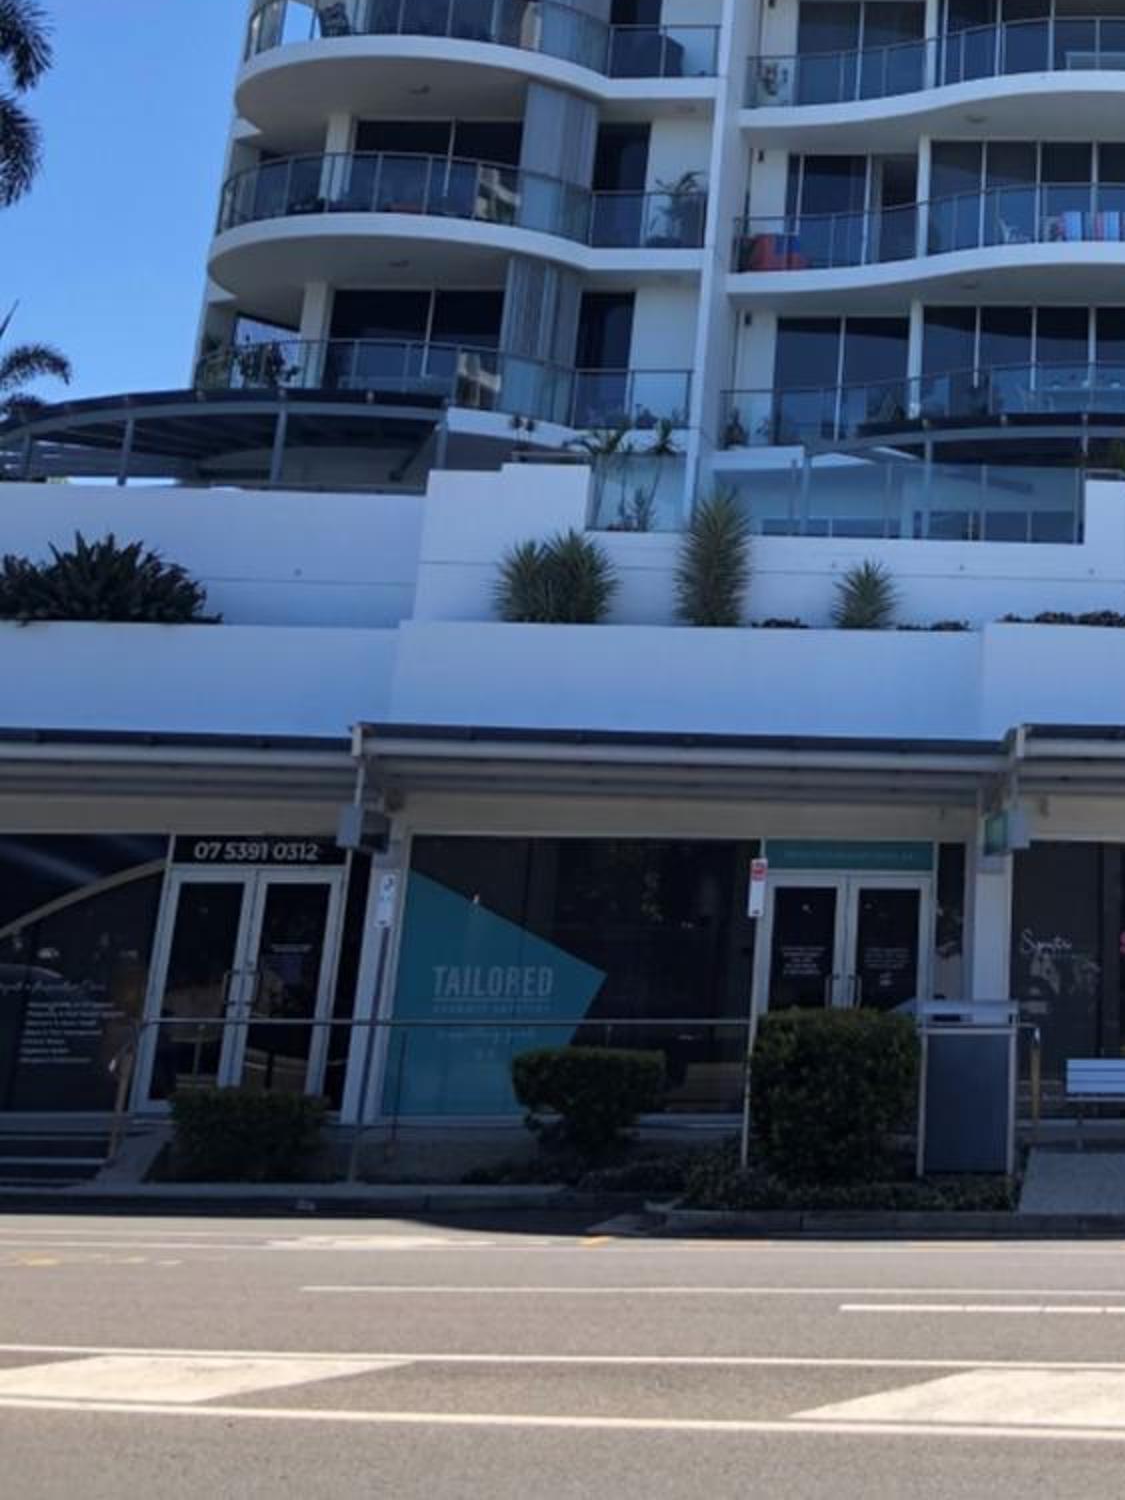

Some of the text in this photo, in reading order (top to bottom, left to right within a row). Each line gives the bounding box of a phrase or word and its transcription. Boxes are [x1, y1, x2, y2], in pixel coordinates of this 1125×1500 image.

[193, 841, 319, 861] 07 5391 0312
[432, 963, 554, 997] TAILORED
